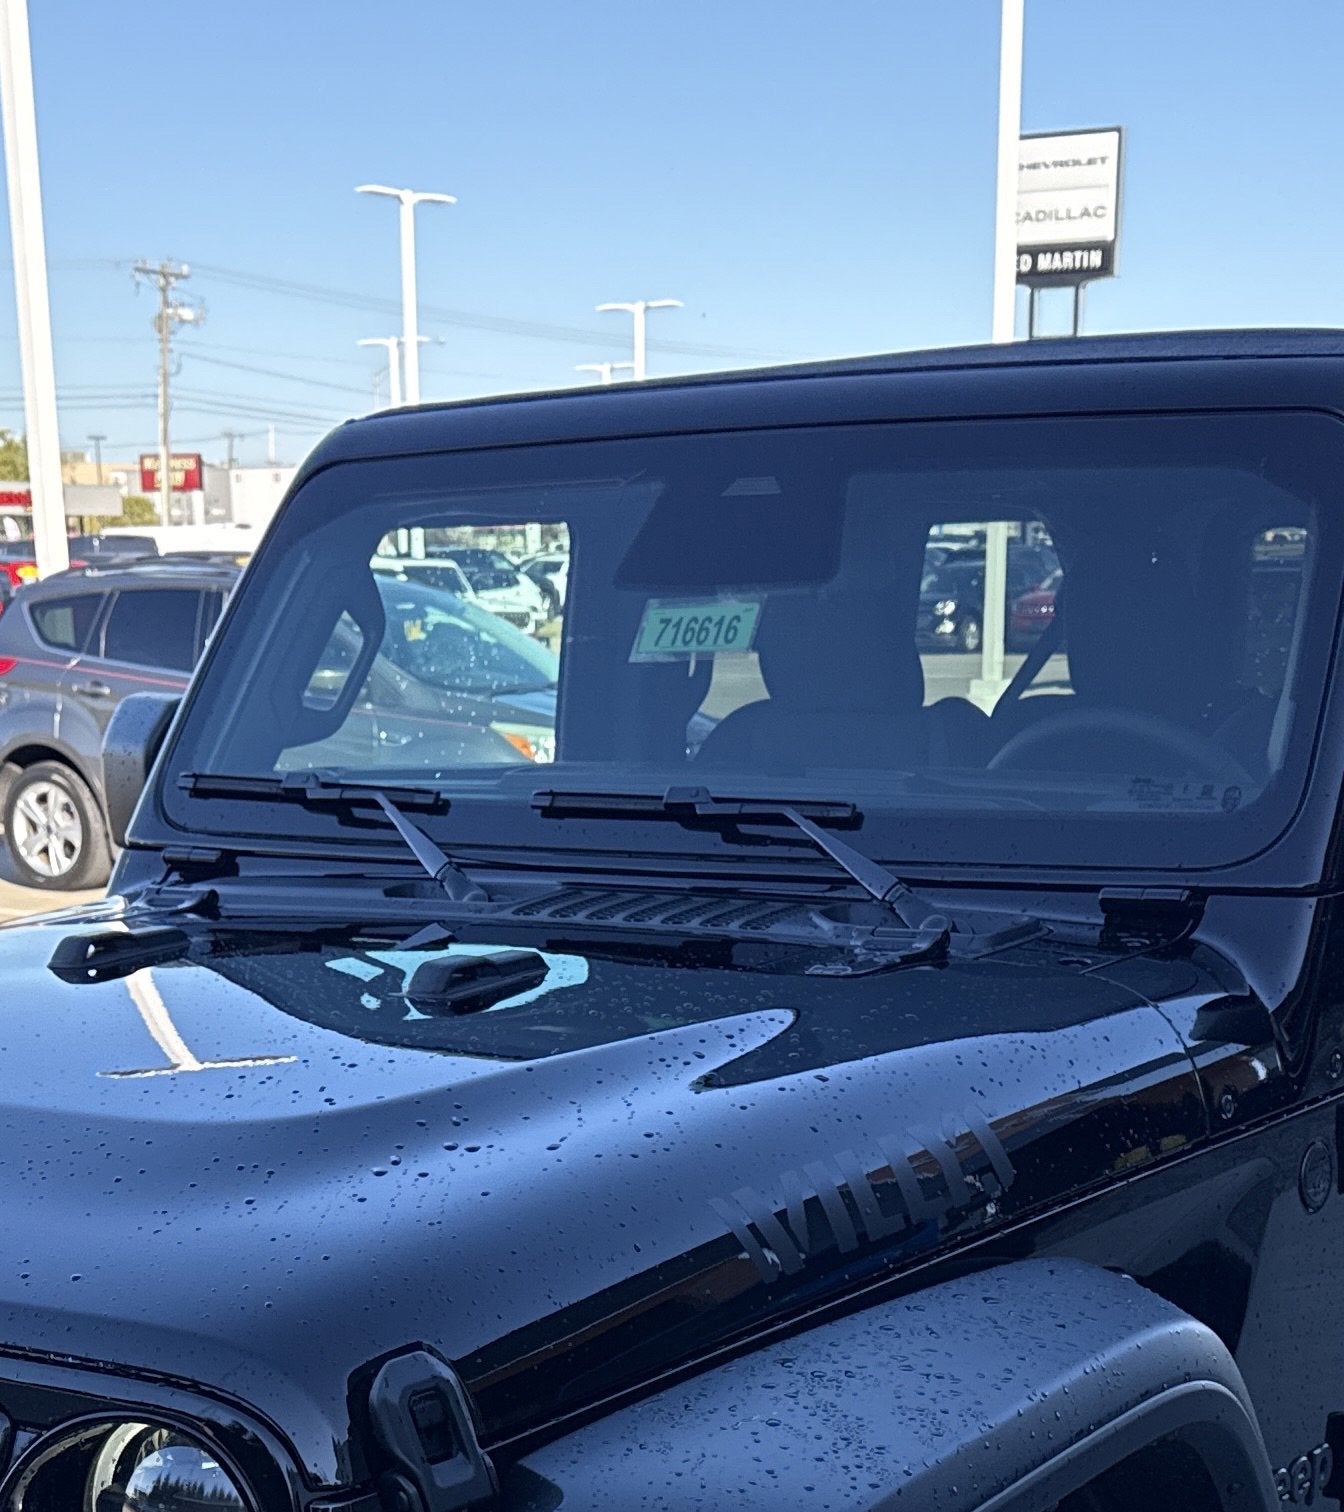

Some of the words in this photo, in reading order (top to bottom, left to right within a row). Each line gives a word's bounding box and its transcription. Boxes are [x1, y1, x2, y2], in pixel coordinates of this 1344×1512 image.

[1037, 248, 1103, 271] MARTIN
[653, 614, 742, 647] 716616
[1272, 1442, 1333, 1500] eep
